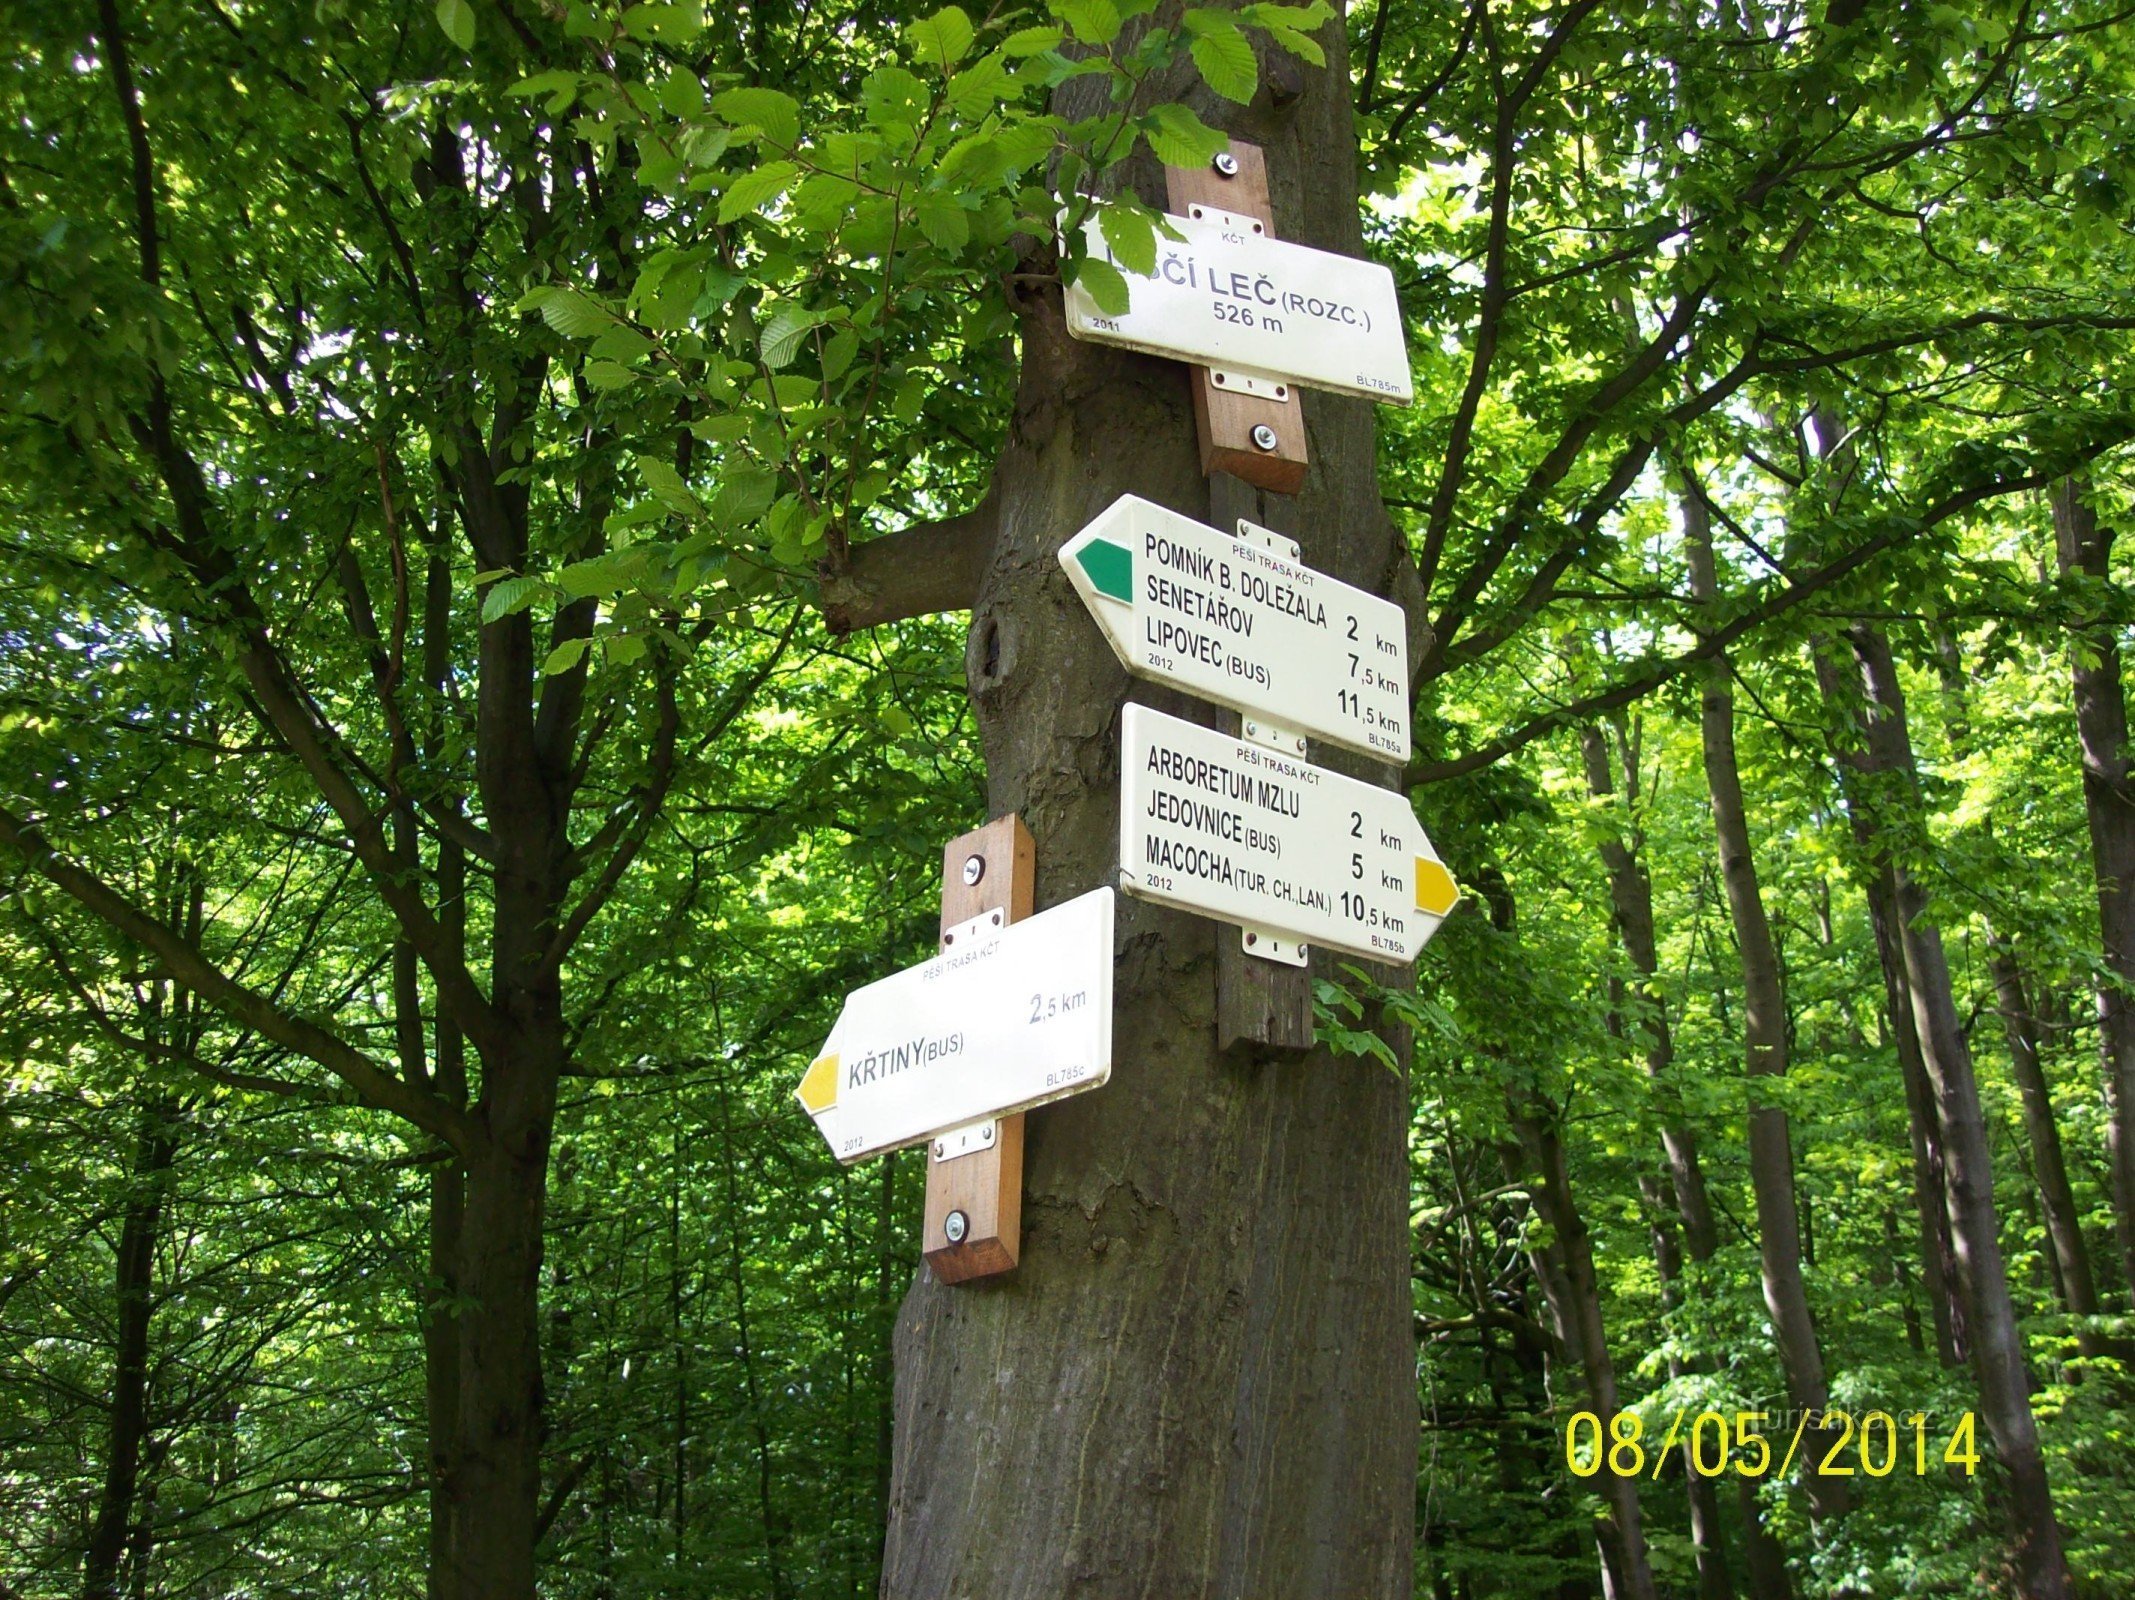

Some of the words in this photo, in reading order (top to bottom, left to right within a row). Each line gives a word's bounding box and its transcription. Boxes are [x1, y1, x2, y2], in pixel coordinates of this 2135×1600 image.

[1221, 231, 1245, 246] KČT
[1208, 267, 1277, 306] LEČ
[1092, 318, 1120, 333] 2011
[1213, 301, 1255, 327] 526
[1263, 316, 1284, 334] m
[1356, 375, 1402, 394] BL785m
[1259, 555, 1293, 578] TRASA
[1295, 570, 1315, 587] KČT
[1145, 532, 1215, 585] POMNÍK
[1219, 563, 1236, 593] B.
[1241, 572, 1328, 630] DOLEŽALA
[1346, 615, 1359, 641] 2
[1376, 634, 1397, 657] km
[1147, 574, 1254, 638] SENETÁŘOV
[1347, 652, 1373, 685] 7,5
[1378, 672, 1399, 696] km
[1146, 616, 1223, 668] LIPOVEC
[1226, 654, 1272, 691] (BUS)
[1338, 689, 1375, 725] 11,5
[1379, 711, 1400, 735] km
[1148, 653, 1174, 672] 2012
[1263, 757, 1297, 779] TRASA
[1300, 770, 1320, 786] KČT
[1147, 745, 1254, 805] ARBORETUM
[1258, 779, 1300, 819] MZLU
[1350, 811, 1363, 839] 2
[1380, 829, 1402, 851] km
[1147, 789, 1242, 844] JEDOVNICE
[1245, 827, 1281, 860] (BUS)
[1351, 853, 1364, 880] 5
[1381, 869, 1403, 892] km
[1146, 834, 1233, 887] MACOCHA
[1340, 891, 1378, 927] 10,5
[1382, 910, 1404, 933] km
[1147, 873, 1173, 892] 2012
[1371, 935, 1405, 955] BL785b
[947, 951, 978, 972] TRASA
[1029, 993, 1056, 1025] 2,5
[1062, 990, 1086, 1012] km
[1045, 1066, 1085, 1087] BL785c
[844, 1137, 863, 1152] 2012
